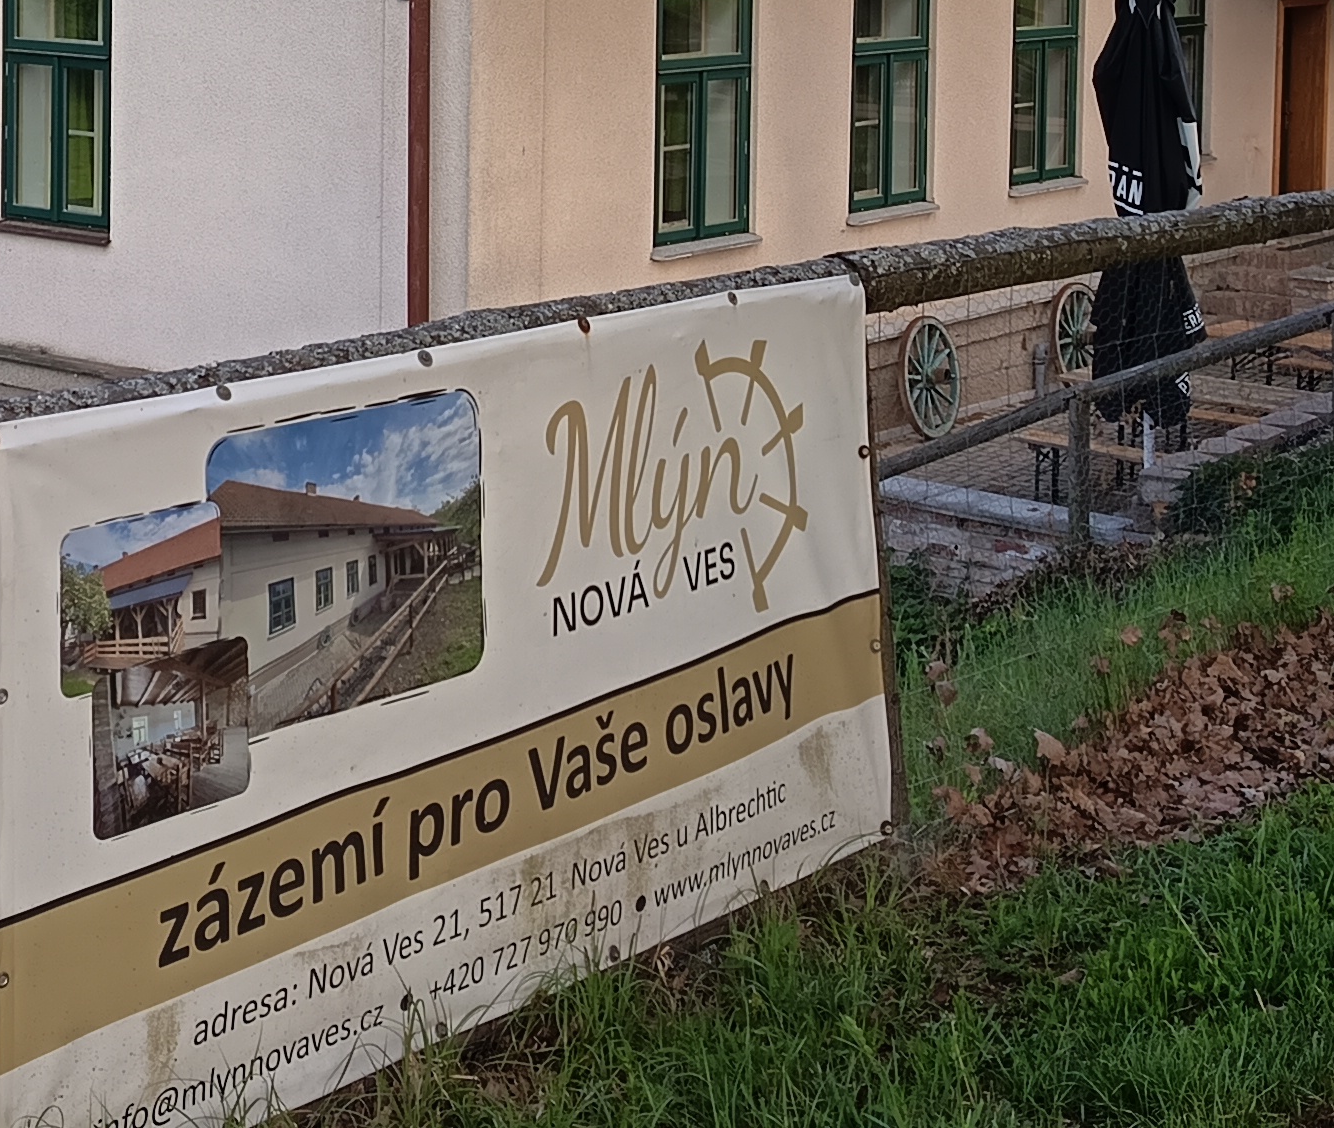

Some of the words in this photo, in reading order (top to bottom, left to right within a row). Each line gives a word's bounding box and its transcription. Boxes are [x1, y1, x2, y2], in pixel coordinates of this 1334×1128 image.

[536, 363, 758, 599] Mlýn
[553, 559, 650, 637] NOVÁ
[683, 542, 736, 592] VES
[158, 796, 391, 969] zázemí
[408, 778, 510, 881] pro
[528, 711, 648, 811] Vaše
[665, 653, 795, 754] oslavy
[193, 982, 297, 1046] adresa:
[308, 941, 374, 999] Nová
[382, 929, 424, 967] Ves
[432, 908, 469, 945] 21,
[479, 885, 522, 928] 517
[530, 876, 558, 909] 21
[571, 841, 627, 891] Nová
[633, 833, 670, 865] Ves
[677, 823, 689, 847] u
[695, 779, 787, 842] Albrechtic
[429, 955, 485, 1000] +420
[492, 936, 532, 978] 727
[538, 917, 578, 957] 970
[584, 898, 623, 938] 990
[653, 808, 837, 909] www.mlynnovaves.cz
